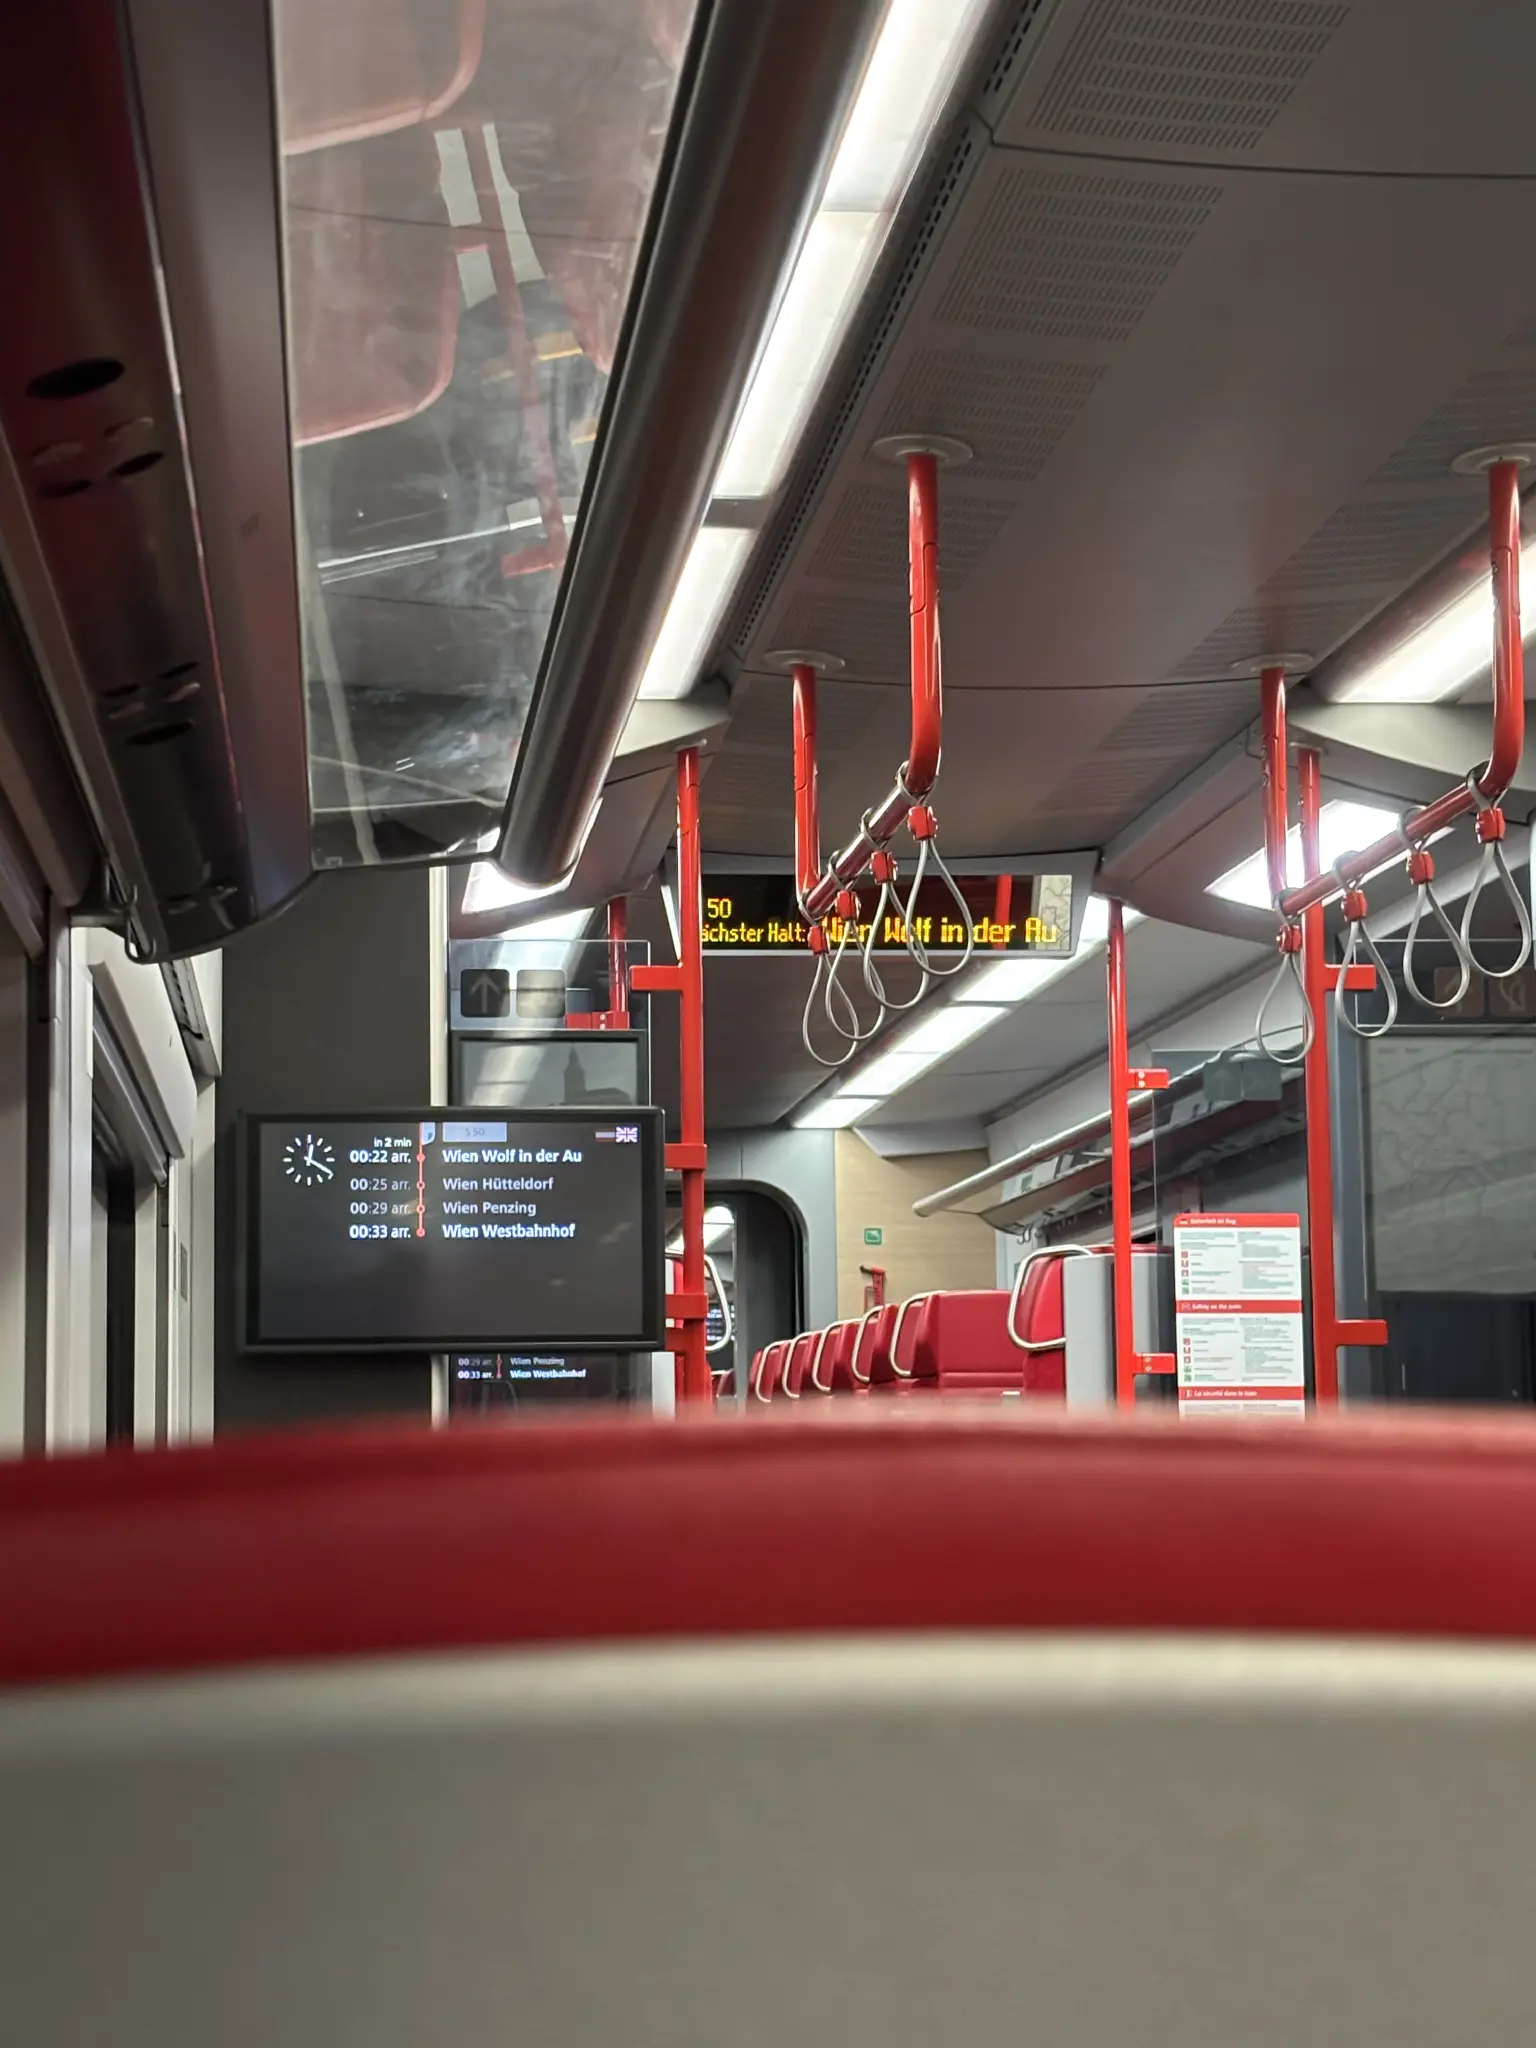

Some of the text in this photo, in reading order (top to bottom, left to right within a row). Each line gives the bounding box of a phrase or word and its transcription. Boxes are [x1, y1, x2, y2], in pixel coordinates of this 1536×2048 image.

[707, 898, 732, 919] 50
[701, 922, 764, 943] ächster
[768, 922, 806, 943] Halt:
[940, 916, 963, 943] in
[972, 916, 1016, 943] der
[1025, 916, 1057, 943] Au
[373, 1137, 412, 1148] in 2 min
[349, 1150, 412, 1163] 00:22 arr.
[442, 1149, 582, 1163] Wien Wolf in der Au
[350, 1178, 411, 1191] 00:25 arr.
[442, 1177, 554, 1190] Wien Hütteldorf
[350, 1202, 411, 1215] 00:29 arr.
[442, 1201, 537, 1217] Wien Penzing
[349, 1225, 411, 1238] 00:33 arr.
[442, 1223, 576, 1238] Wien Westbahnhof
[510, 1357, 531, 1365] Wien
[510, 1369, 586, 1378] Wien Westbahnhof
